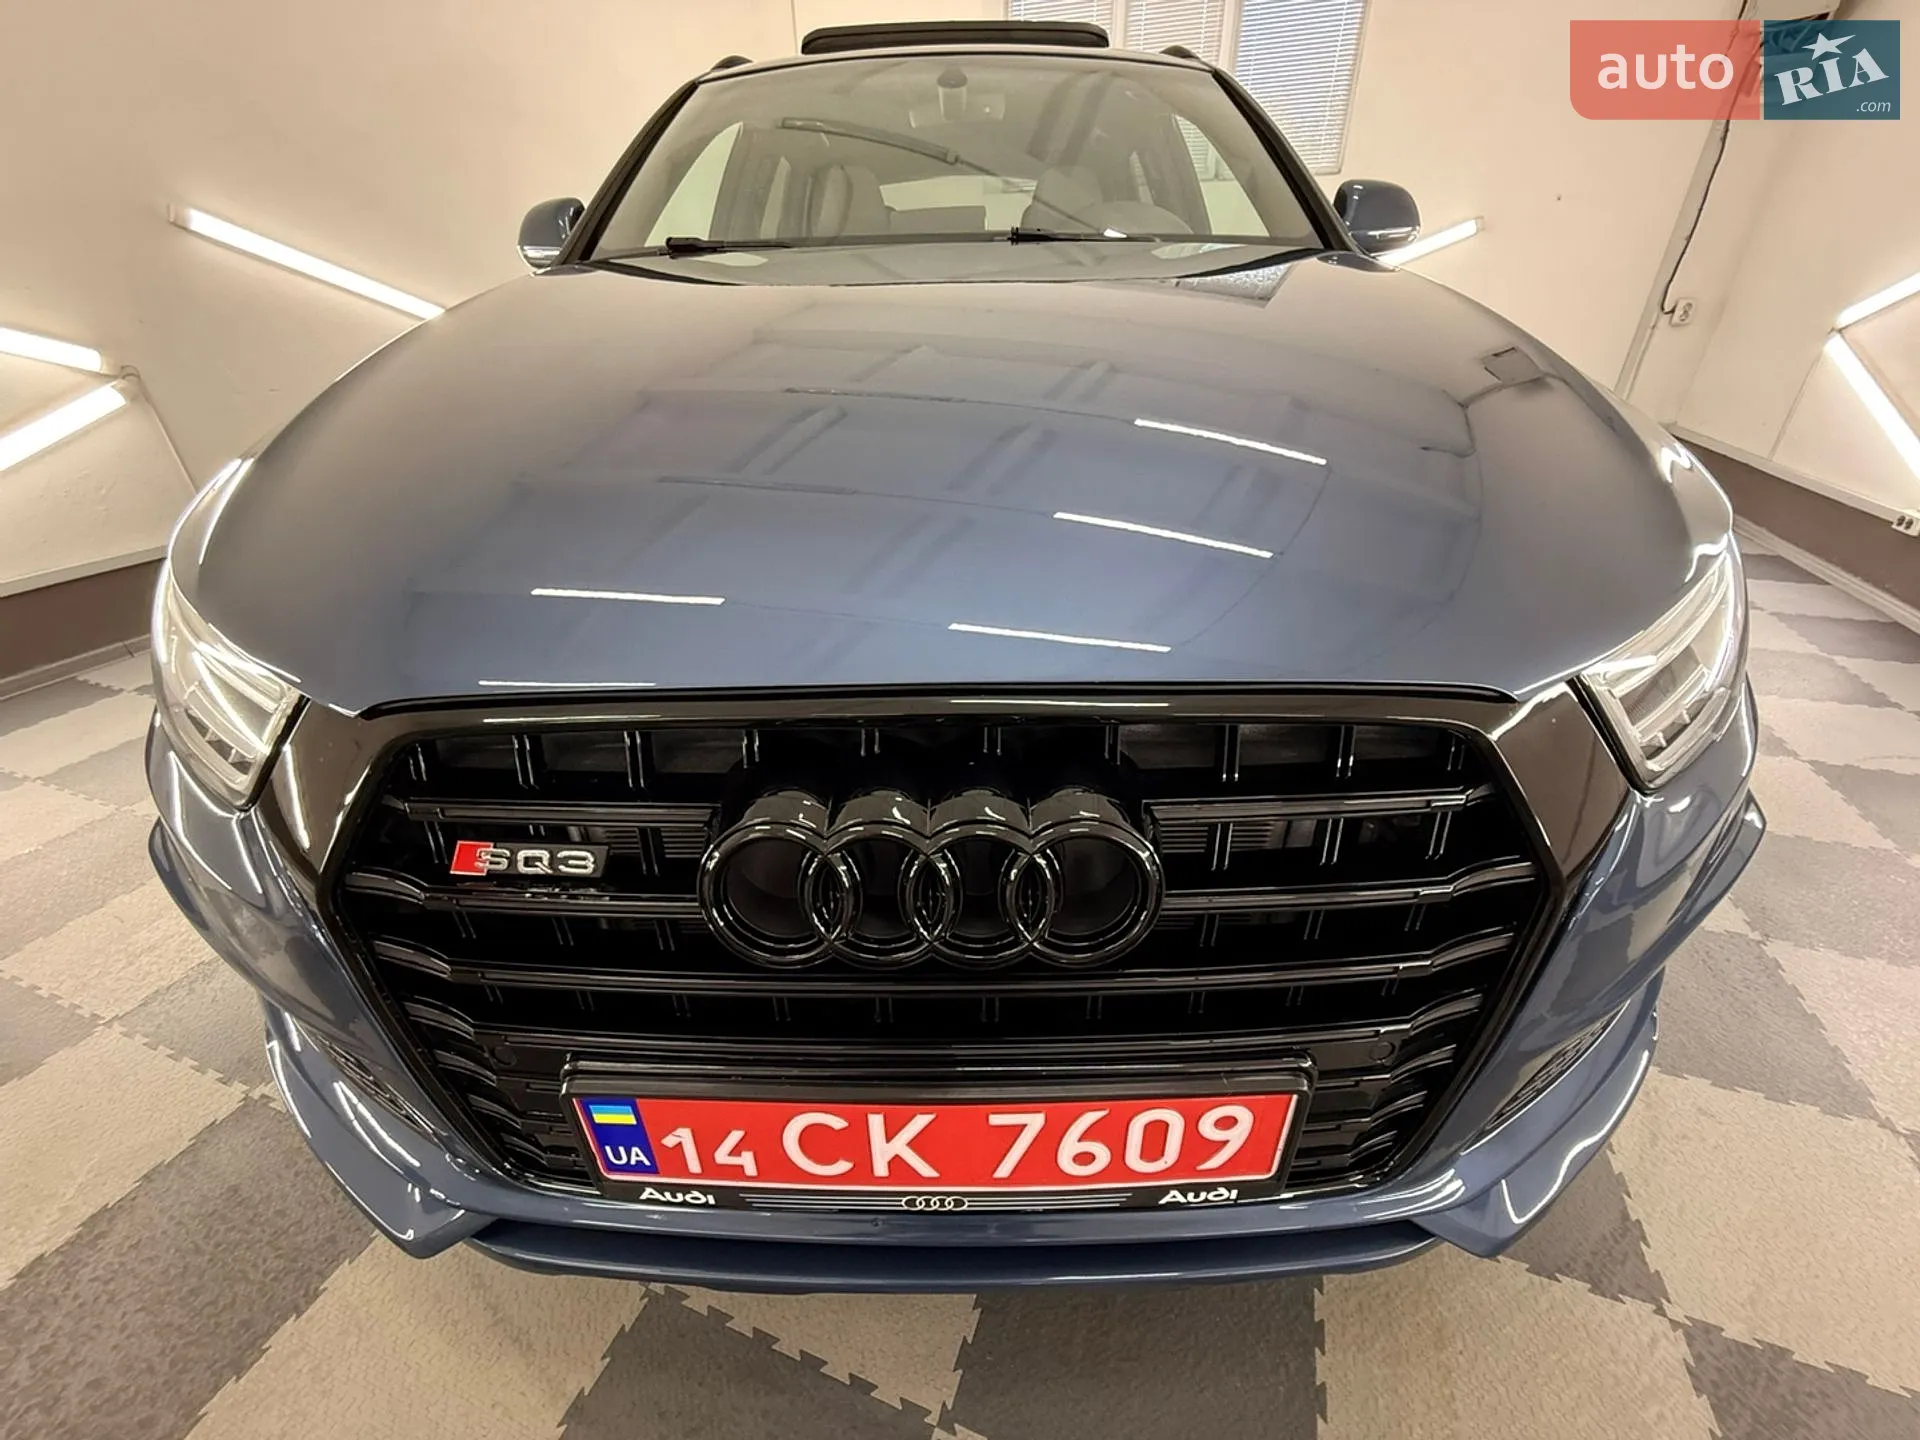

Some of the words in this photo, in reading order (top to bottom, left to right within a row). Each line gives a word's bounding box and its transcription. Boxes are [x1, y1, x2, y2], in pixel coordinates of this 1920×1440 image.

[474, 847, 596, 875] SQ3
[661, 1127, 757, 1177] 14
[781, 1110, 941, 1179] CK
[987, 1104, 1255, 1179] 7609
[605, 1144, 651, 1167] UA
[638, 1187, 716, 1206] Audi
[1157, 1187, 1238, 1204] Audi
